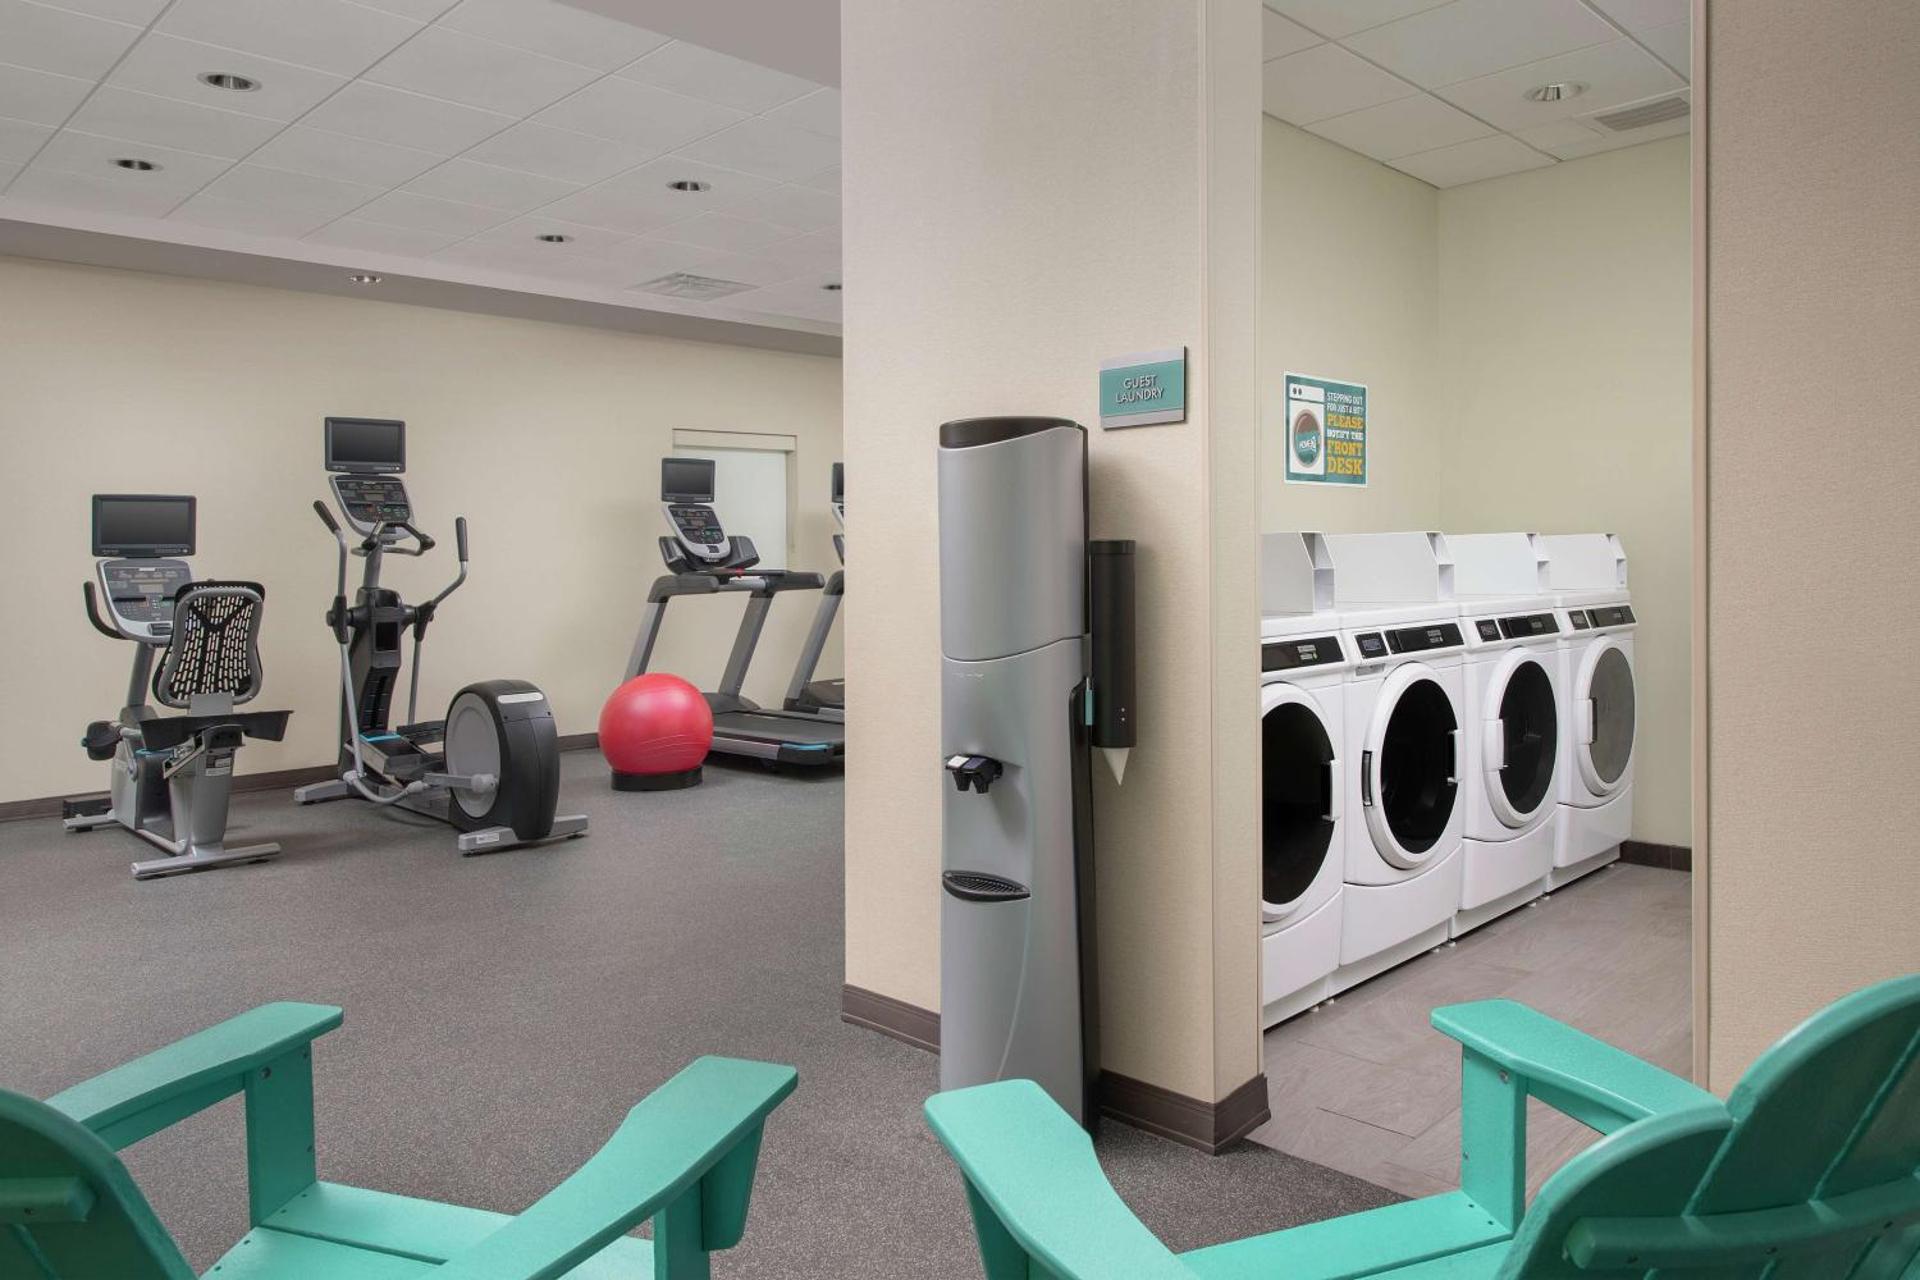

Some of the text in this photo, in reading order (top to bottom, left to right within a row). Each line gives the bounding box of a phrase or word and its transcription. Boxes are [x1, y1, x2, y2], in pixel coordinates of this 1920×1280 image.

[1123, 374, 1157, 388] GUEST
[1115, 387, 1164, 403] LAUNDRY
[1327, 393, 1363, 405] STEPPING OUT
[1327, 403, 1336, 412] FOR
[1337, 404, 1348, 413] JUST
[1328, 413, 1363, 429] PLEASE
[1327, 429, 1363, 440] NOTIFY THE
[1328, 440, 1362, 456] FRONT
[1328, 456, 1362, 475] DESK
